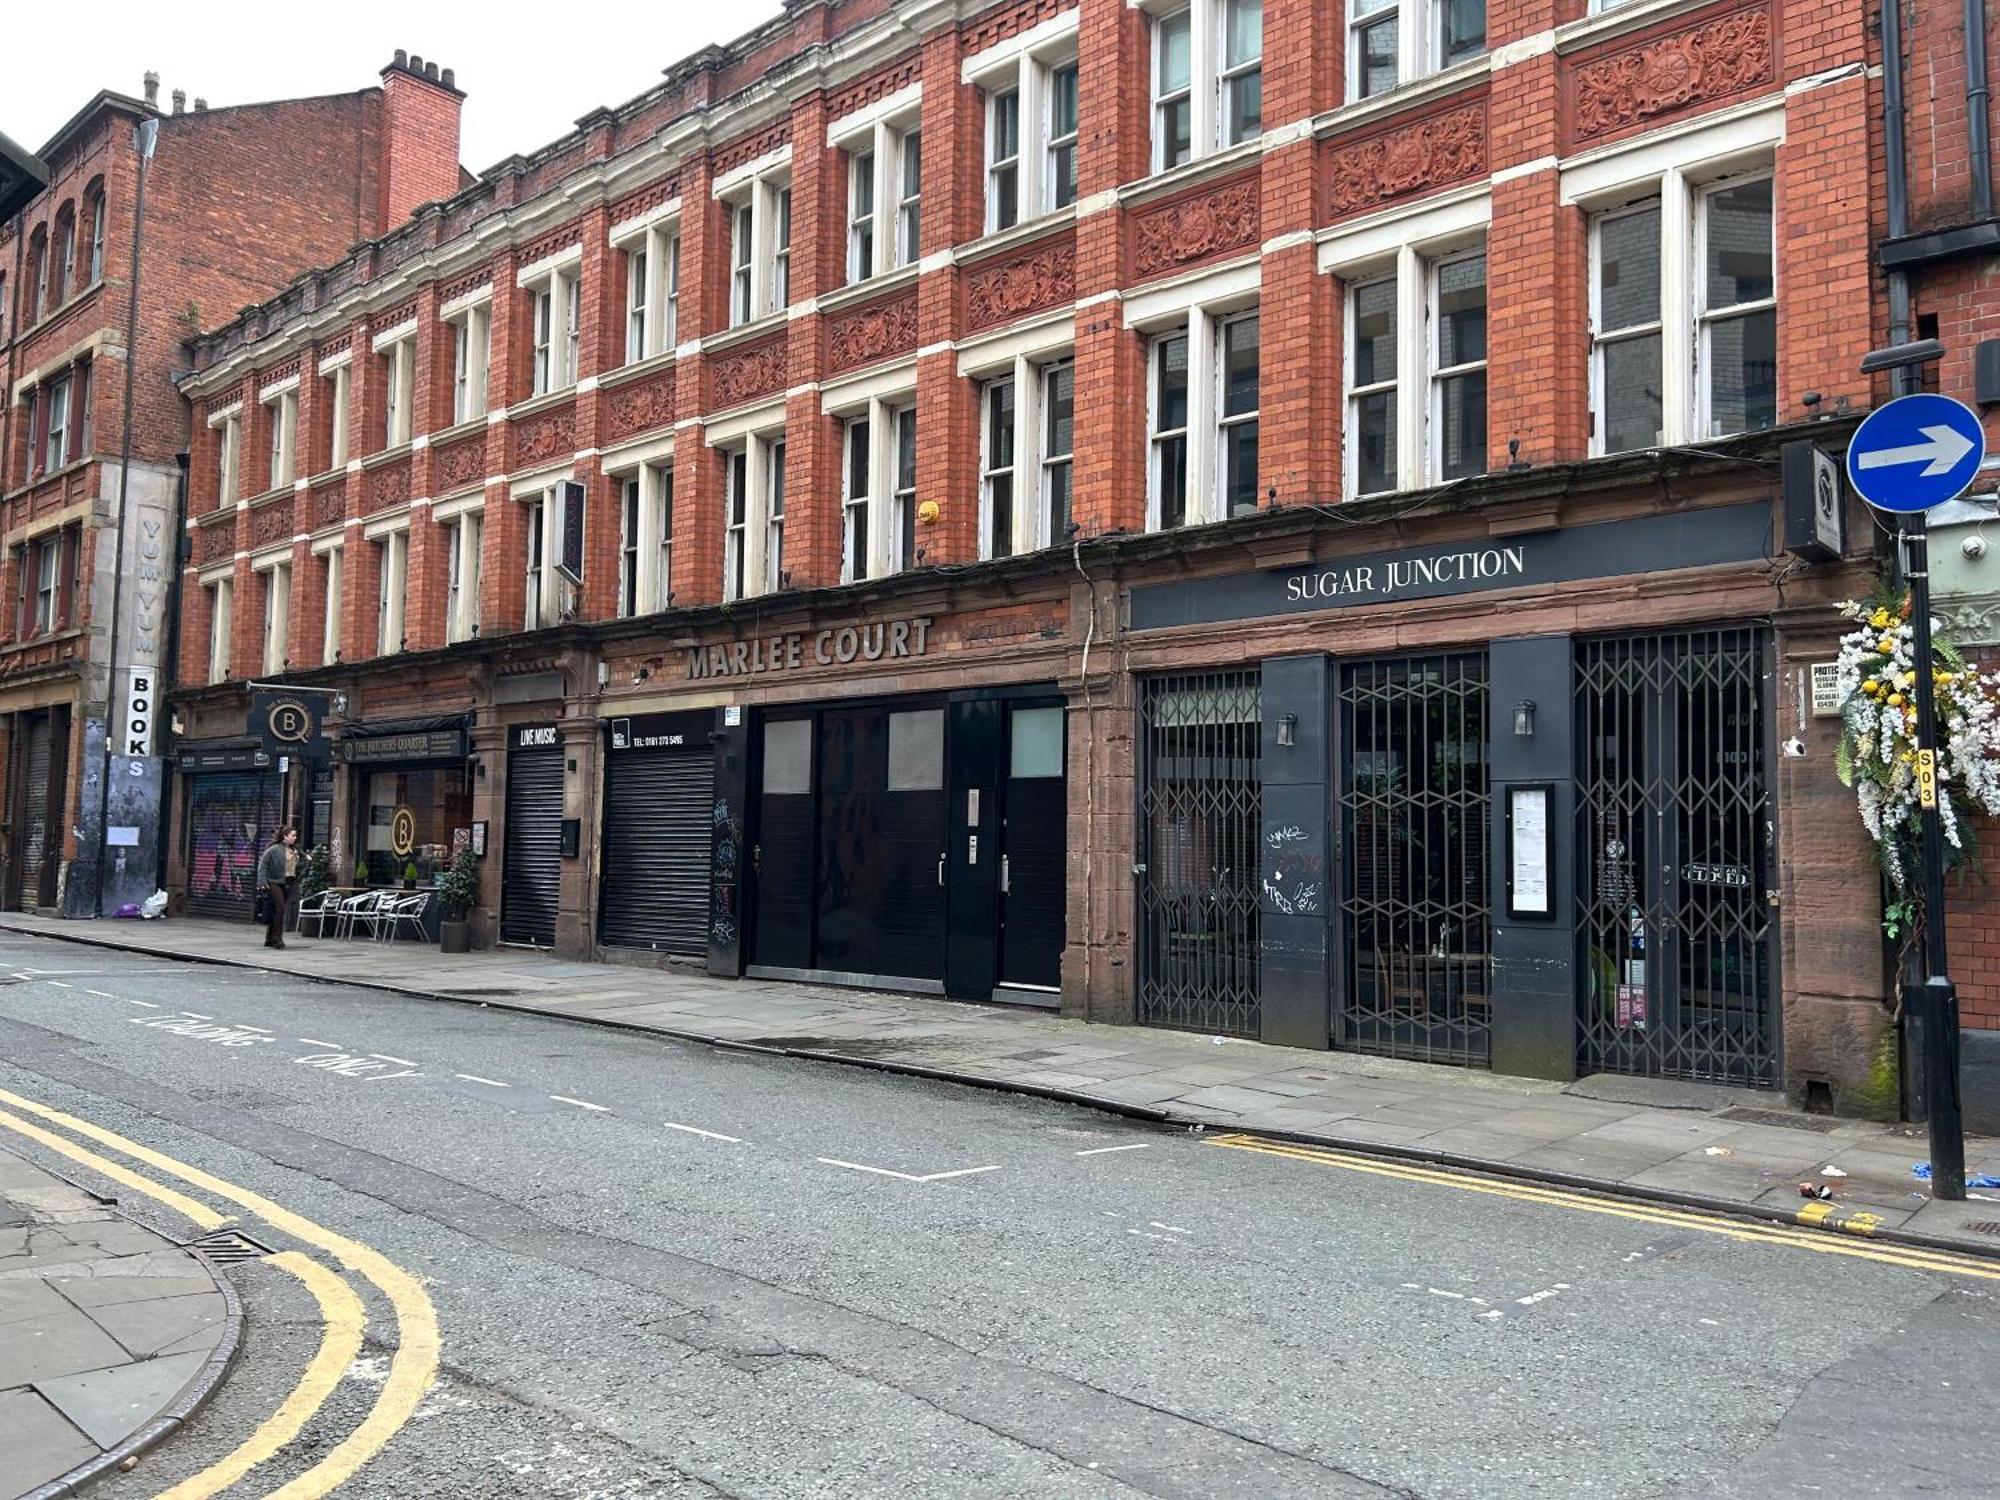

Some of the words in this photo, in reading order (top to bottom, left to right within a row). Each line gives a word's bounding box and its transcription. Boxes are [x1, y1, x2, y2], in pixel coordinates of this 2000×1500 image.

[1287, 567, 1375, 601] SUGAR
[1382, 546, 1524, 593] JUNCTION
[685, 634, 801, 680] MARLEE
[816, 619, 932, 665] COURT
[128, 677, 149, 777] BOOKS
[519, 729, 534, 746] LIVE
[534, 727, 556, 745] MUSIC
[129, 1015, 277, 1046] LOADING
[294, 1054, 425, 1080] ONLY
